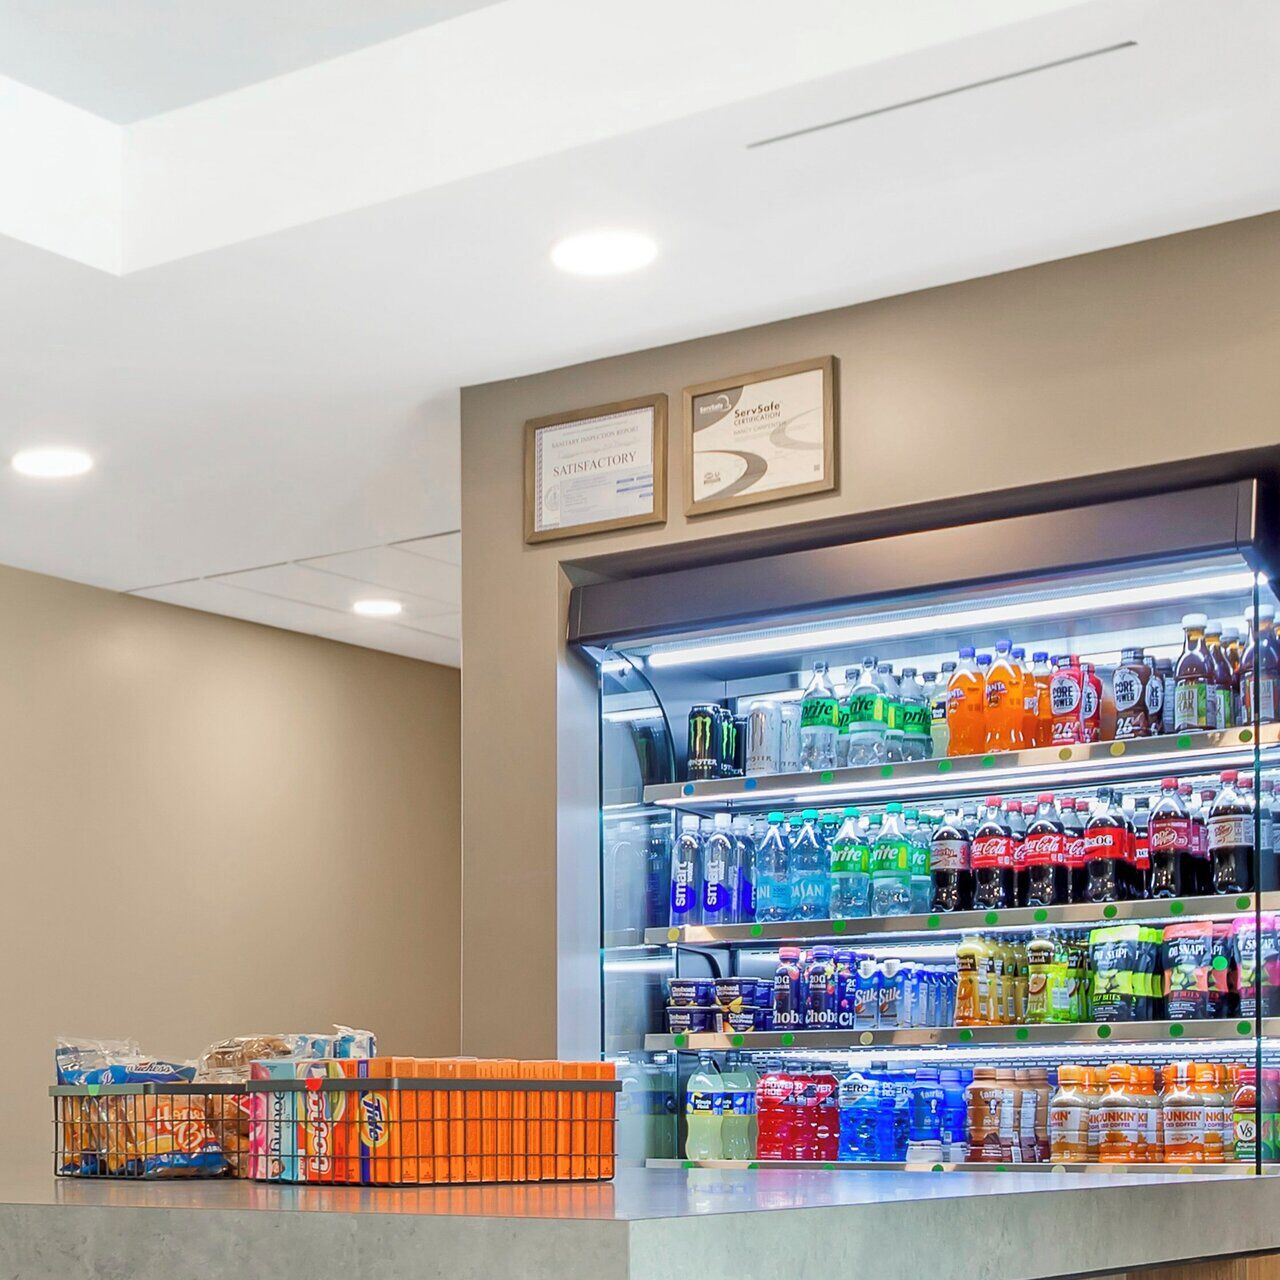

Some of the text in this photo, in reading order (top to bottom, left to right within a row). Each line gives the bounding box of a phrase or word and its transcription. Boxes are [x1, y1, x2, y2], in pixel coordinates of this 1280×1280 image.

[734, 400, 781, 419] ServSafe
[553, 451, 637, 477] SATISFACTORY
[1052, 685, 1074, 699] CORE
[1115, 679, 1135, 693] CORE
[802, 700, 833, 721] prite
[831, 846, 862, 862] prite
[675, 861, 688, 907] smart
[707, 860, 719, 906] smart
[855, 988, 878, 1007] Silk
[879, 986, 902, 1006] Silk
[362, 1097, 384, 1142] Tide
[1100, 1111, 1136, 1122] UNKIN'
[1239, 1123, 1253, 1138] V8
